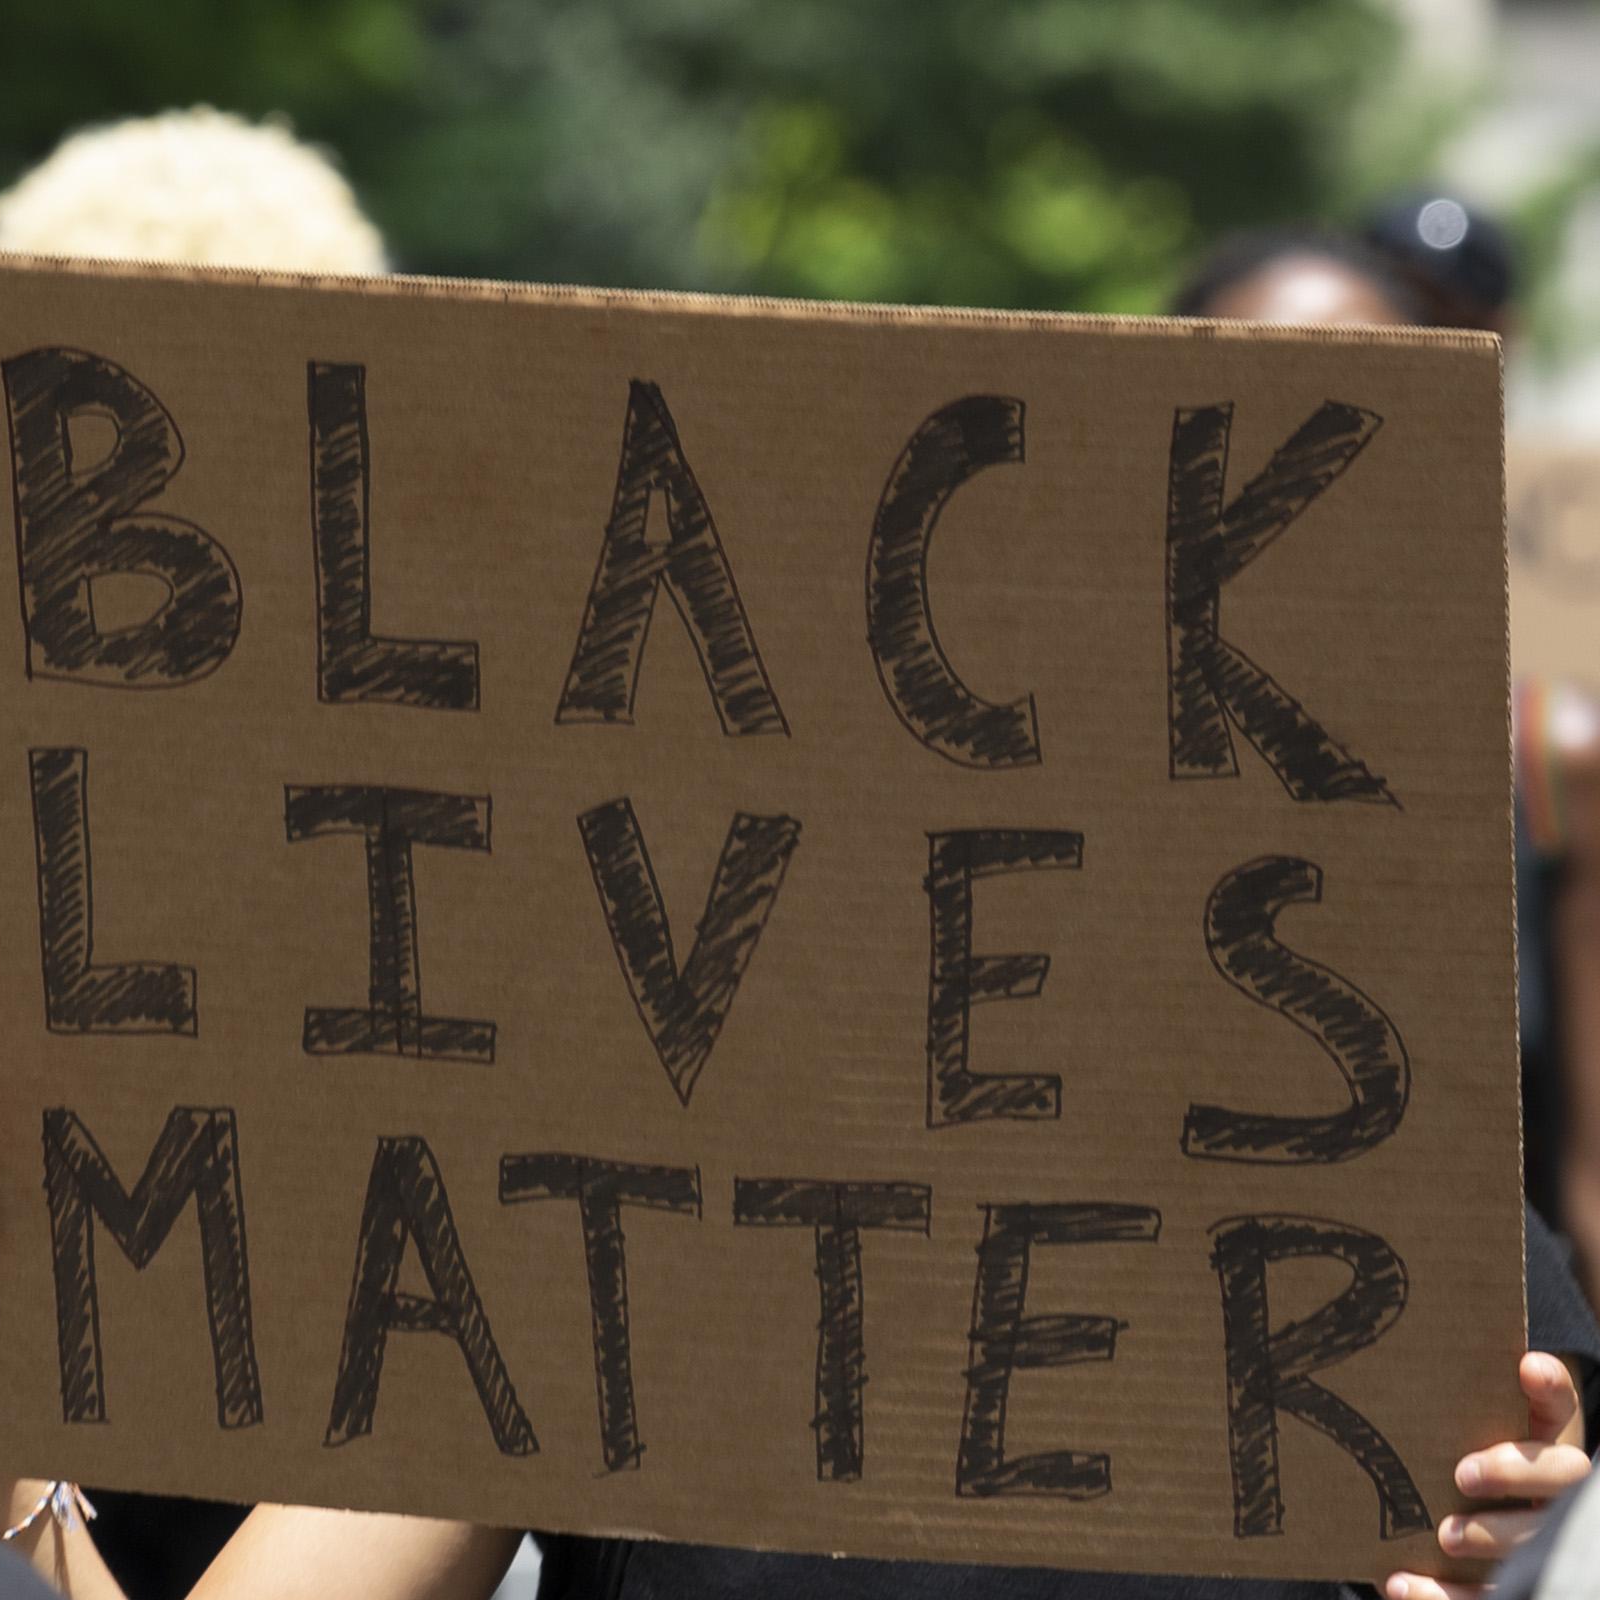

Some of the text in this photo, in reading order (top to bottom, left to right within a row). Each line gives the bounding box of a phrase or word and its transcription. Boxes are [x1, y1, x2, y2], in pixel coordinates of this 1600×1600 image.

[2, 346, 1400, 810] BLACK
[27, 746, 1410, 1164] LIVES
[41, 1106, 1434, 1538] MATTER
